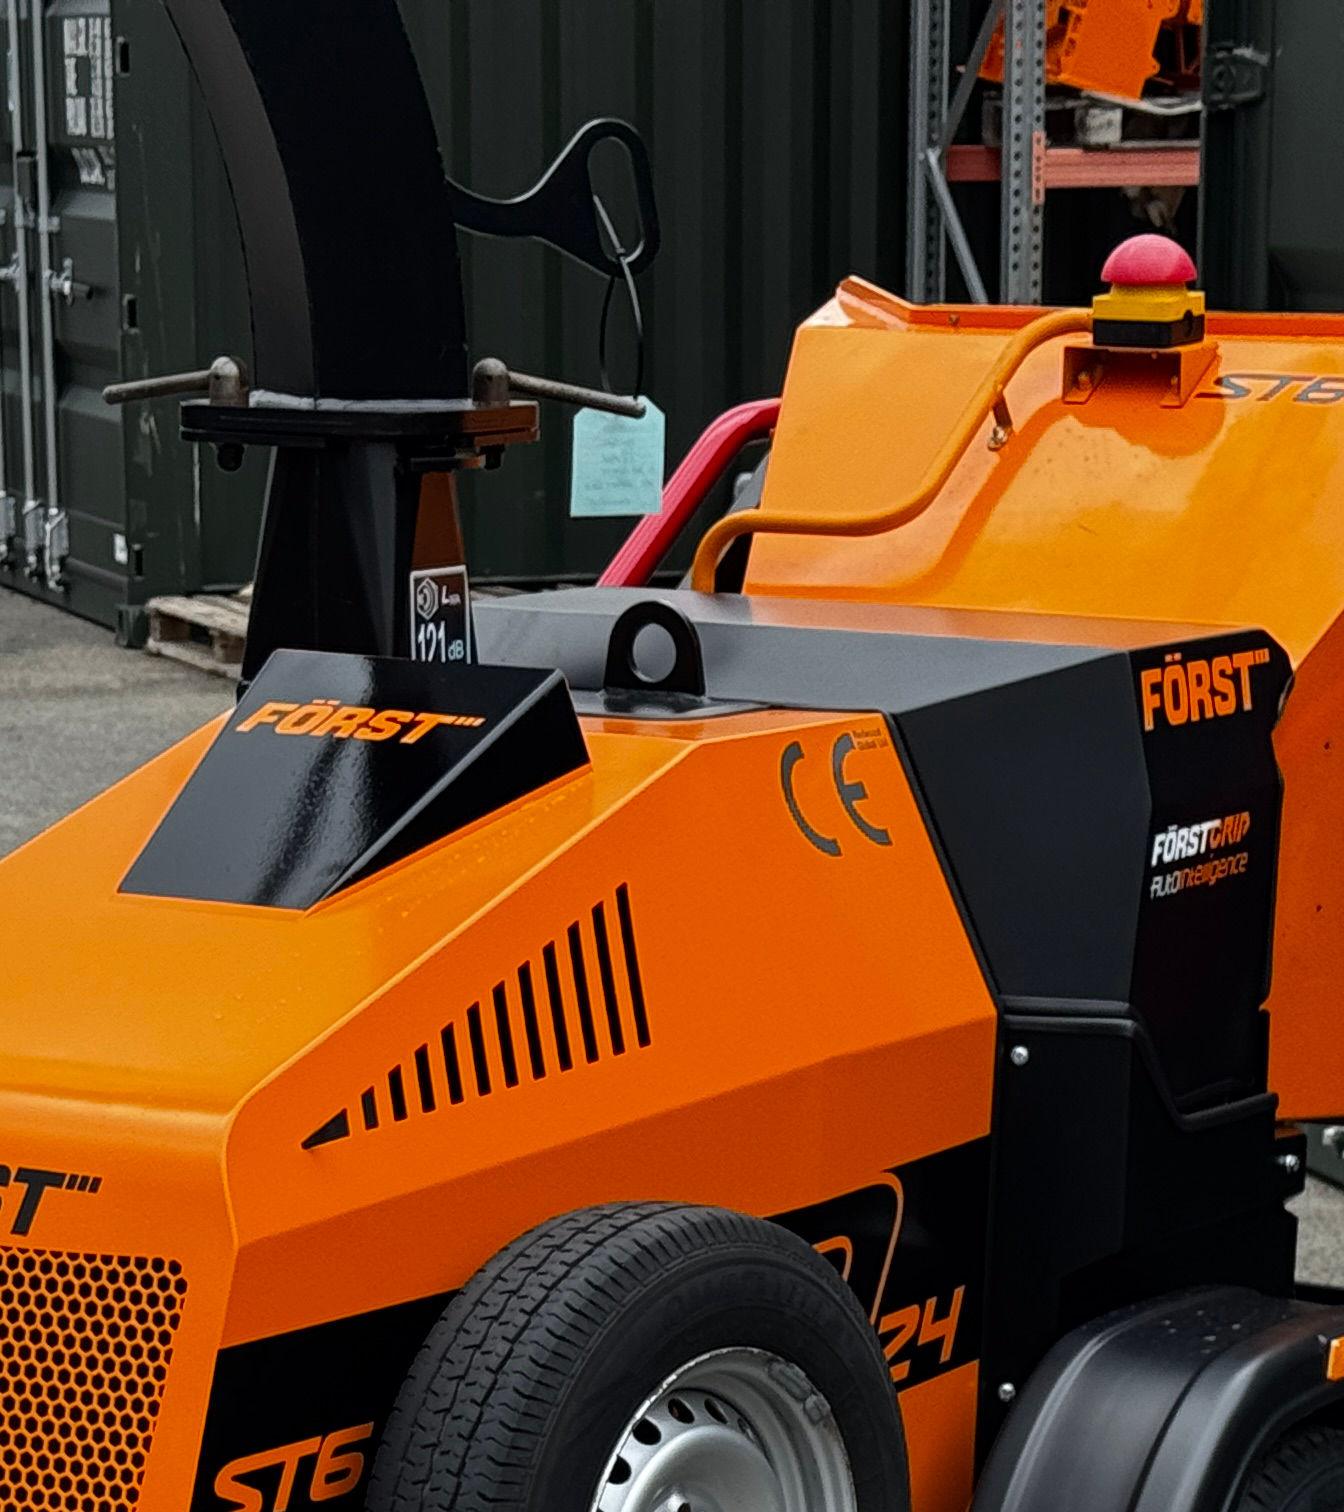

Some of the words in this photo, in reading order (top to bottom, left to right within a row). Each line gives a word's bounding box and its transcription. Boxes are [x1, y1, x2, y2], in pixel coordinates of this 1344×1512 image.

[417, 620, 447, 663] 121
[1140, 652, 1255, 732] FÖRST
[234, 698, 458, 745] FÖRST
